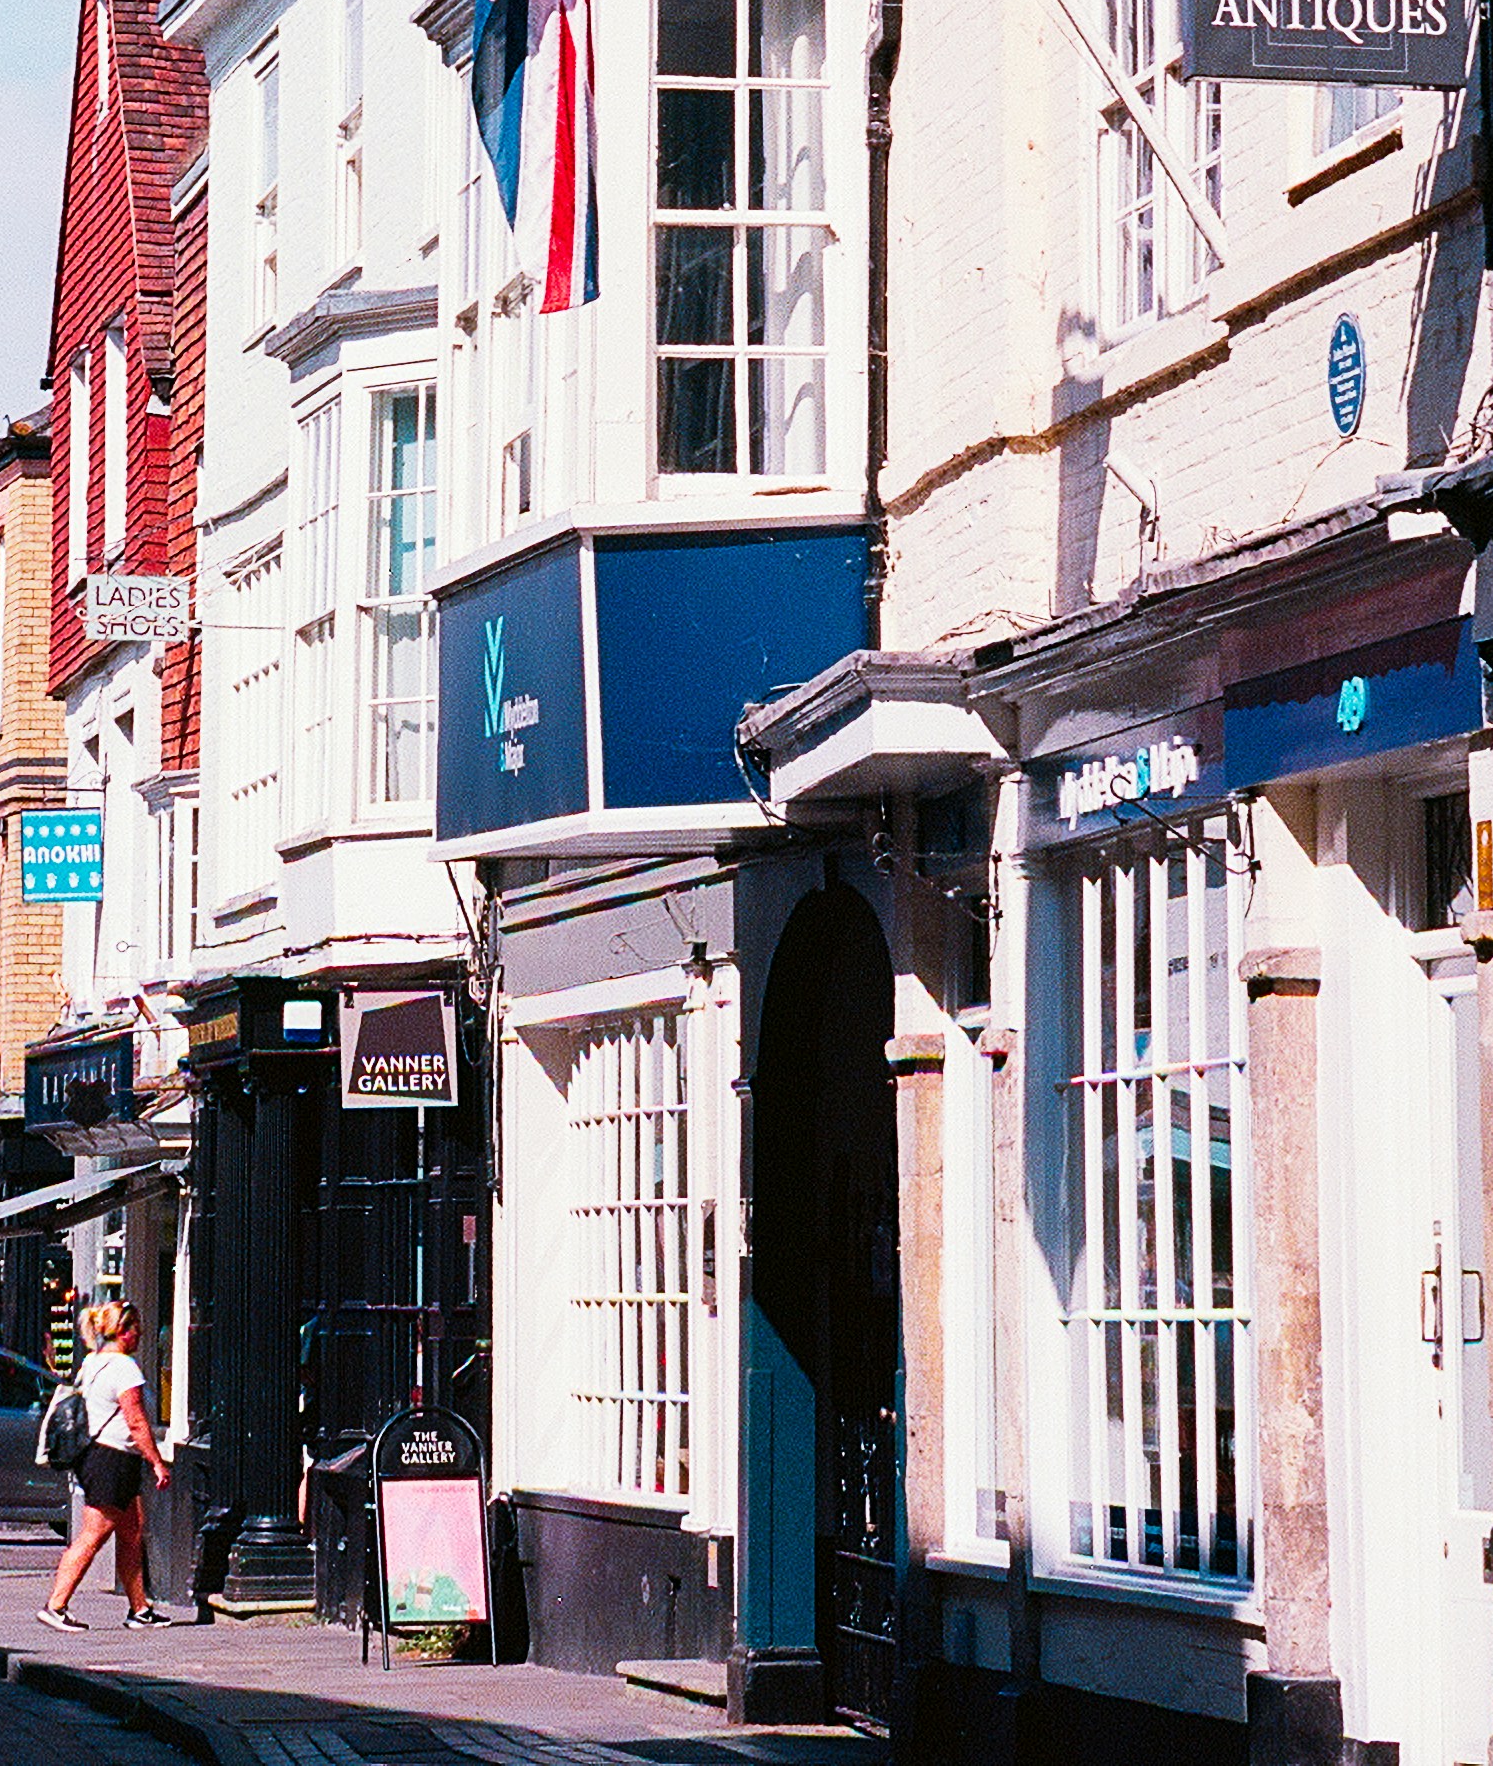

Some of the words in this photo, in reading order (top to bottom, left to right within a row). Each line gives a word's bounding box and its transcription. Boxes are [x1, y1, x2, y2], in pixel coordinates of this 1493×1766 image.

[94, 584, 182, 609] LADIES
[96, 615, 180, 638] SHOES
[360, 1054, 446, 1073] VANNER
[357, 1072, 447, 1092] GALLERY
[413, 1431, 438, 1442] THE
[401, 1441, 453, 1453] VANNER
[401, 1451, 456, 1465] GALLERY
